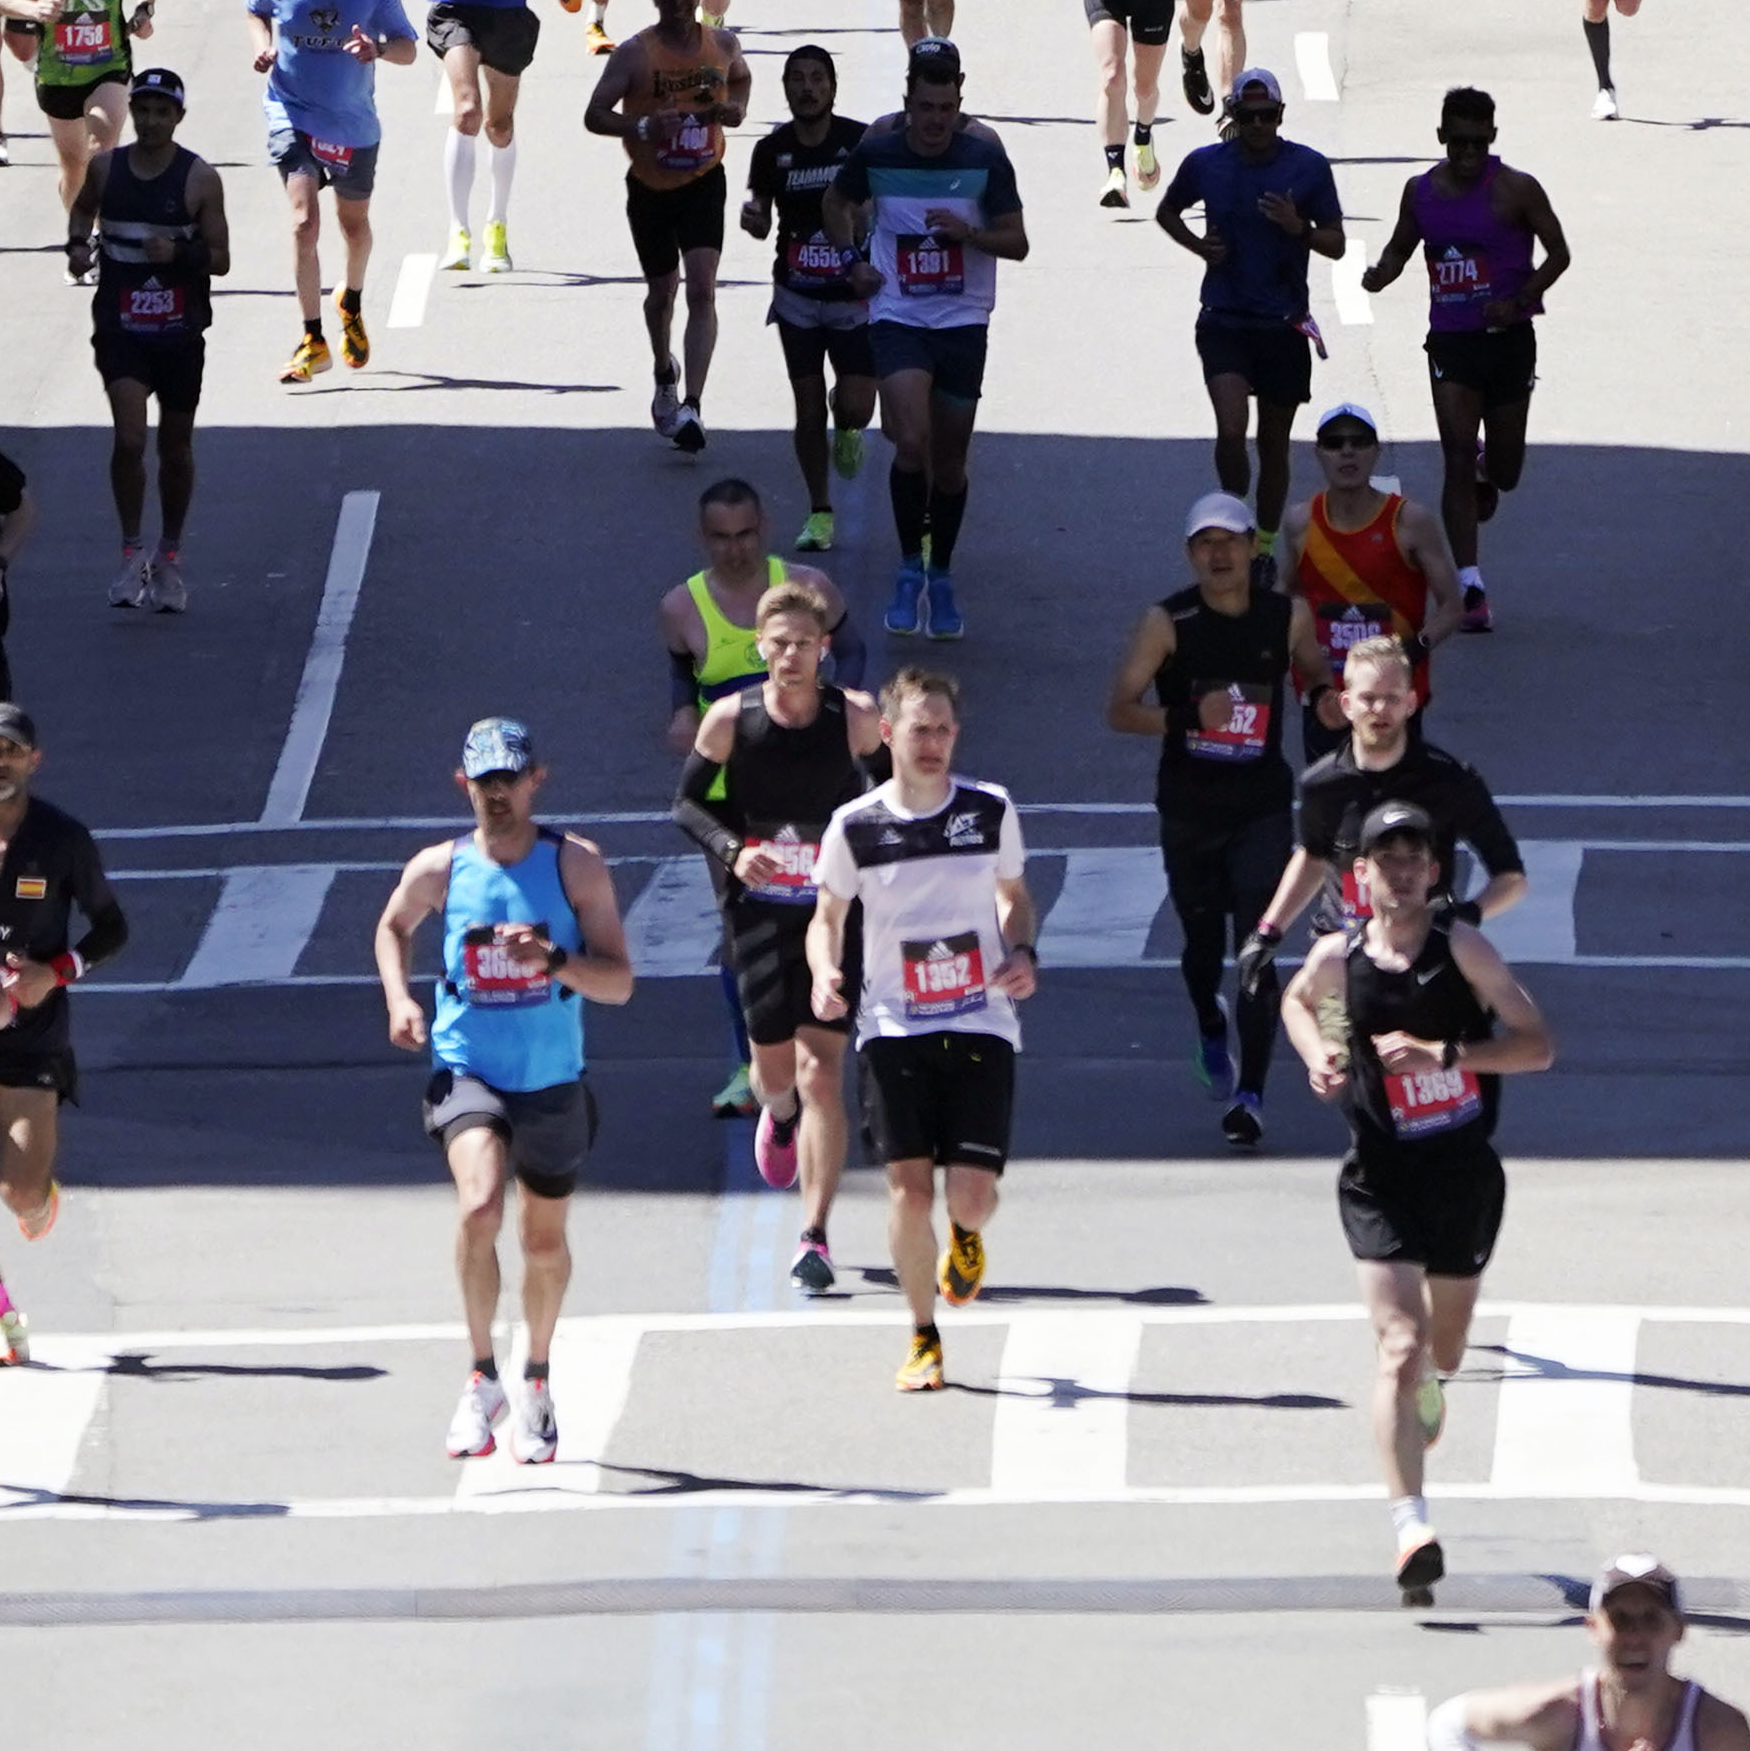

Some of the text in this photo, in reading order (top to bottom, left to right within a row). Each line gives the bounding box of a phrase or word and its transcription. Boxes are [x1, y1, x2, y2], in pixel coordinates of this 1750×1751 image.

[65, 25, 104, 46] 1758
[131, 290, 175, 314] 2253
[916, 954, 971, 991] 1352
[1406, 1071, 1465, 1109] 1369
